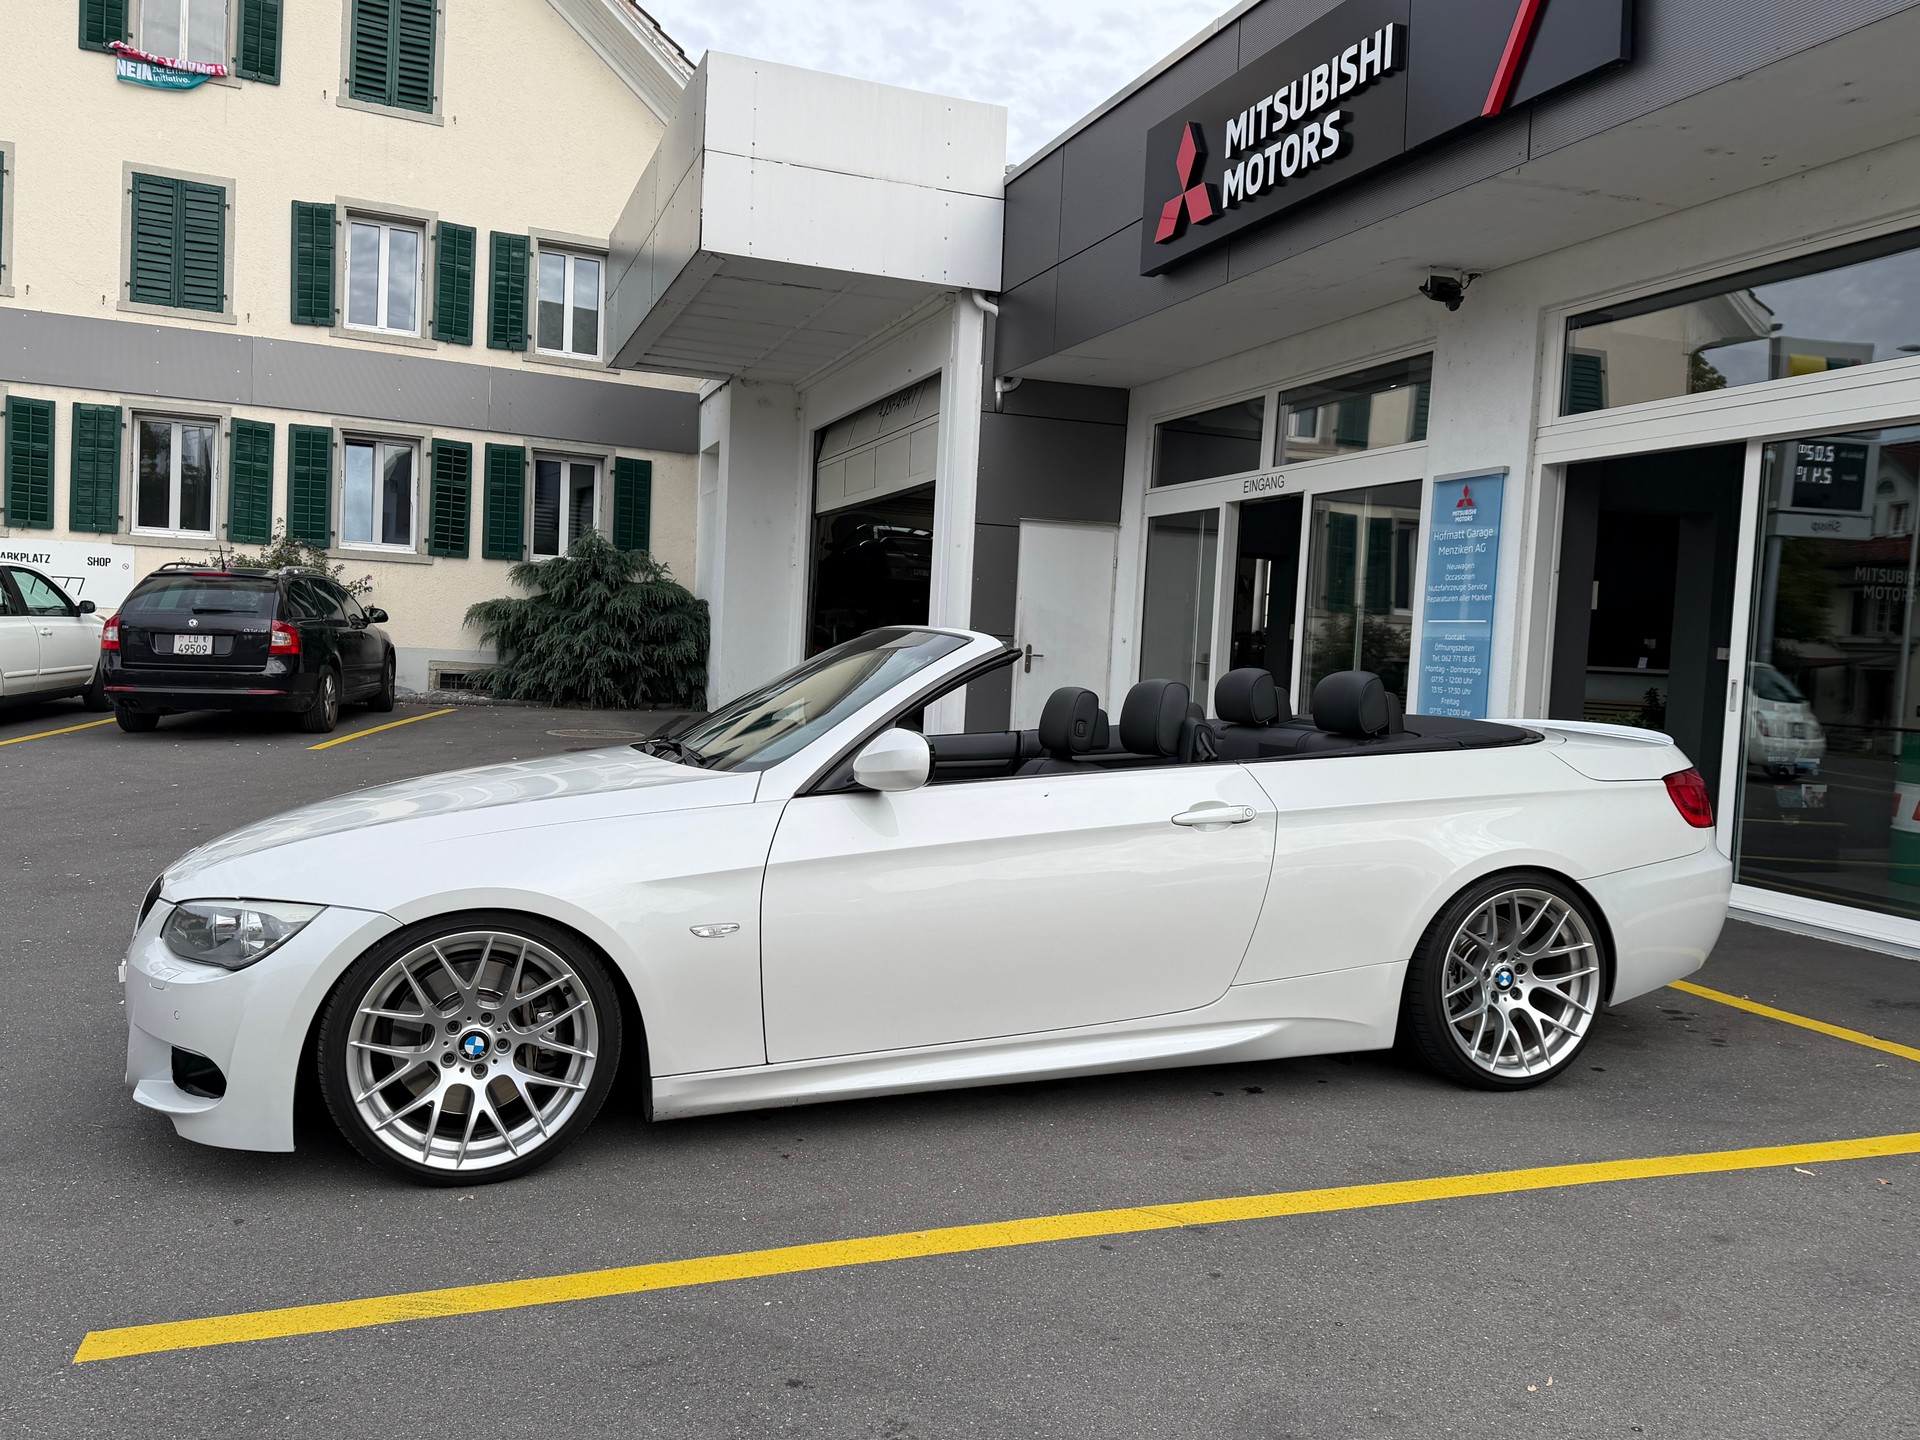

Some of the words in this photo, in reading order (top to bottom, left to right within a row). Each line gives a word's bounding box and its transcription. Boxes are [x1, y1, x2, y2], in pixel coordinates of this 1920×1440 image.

[117, 59, 152, 80] NEIN
[1225, 22, 1393, 159] MITSUBISHI
[1222, 110, 1340, 209] MOTORS
[1243, 475, 1285, 493] EINGANG
[1434, 531, 1465, 541] Hofmatt
[1466, 528, 1494, 539] Garage
[1438, 545, 1474, 555] Menziken
[1475, 543, 1486, 553] AG
[87, 557, 111, 567] SHOP
[1446, 563, 1475, 571] Neuwagen
[1445, 573, 1475, 581] Occasionen
[1468, 582, 1488, 590] Service
[189, 635, 198, 643] LU
[178, 644, 208, 654] 49509
[1425, 665, 1446, 674] Montag
